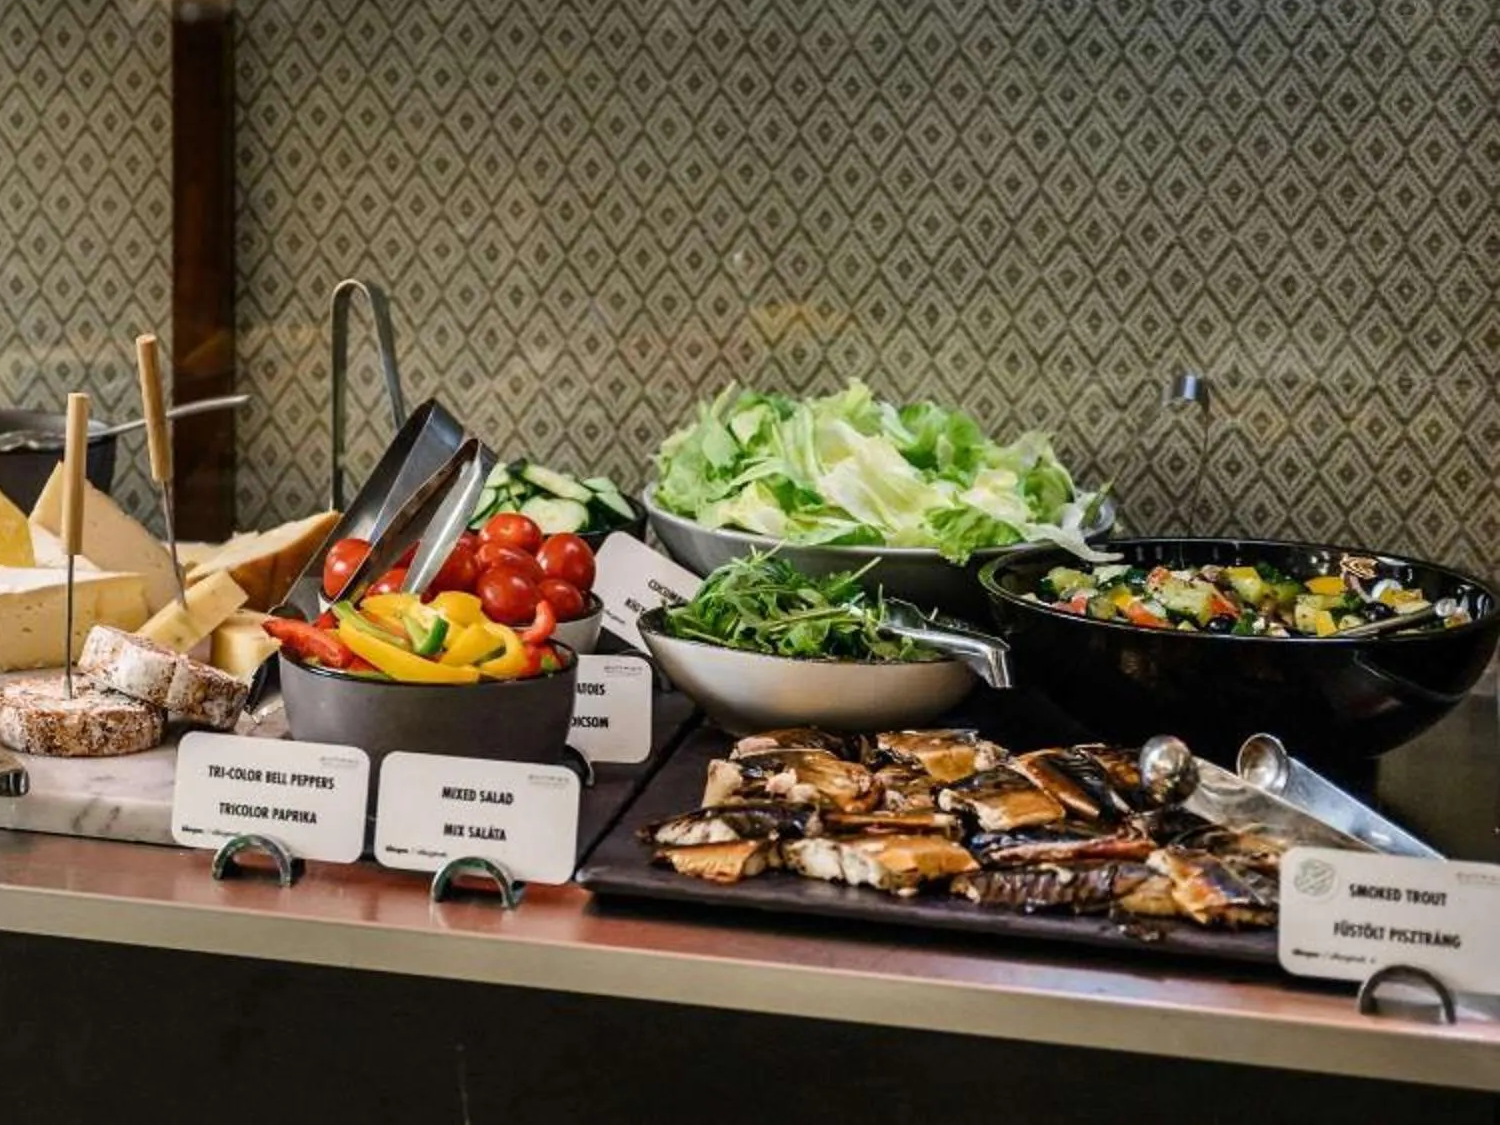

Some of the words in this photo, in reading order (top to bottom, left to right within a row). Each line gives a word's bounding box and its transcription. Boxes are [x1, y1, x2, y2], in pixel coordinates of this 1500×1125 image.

[571, 715, 609, 728] DICSOM
[208, 764, 263, 783] TRI-COLOR
[265, 770, 289, 786] BELL
[290, 773, 336, 790] PEPPERS
[441, 786, 477, 802] MIXED
[479, 791, 514, 805] SALAD
[218, 802, 269, 820] TRICOLOR
[271, 807, 318, 824] PAPRIKA
[443, 823, 465, 837] MIX
[468, 824, 507, 841] SALÁTA
[1349, 883, 1401, 903] SMOKED
[1405, 888, 1448, 907] TROUT
[1388, 928, 1462, 950] PISZTRÁNG
